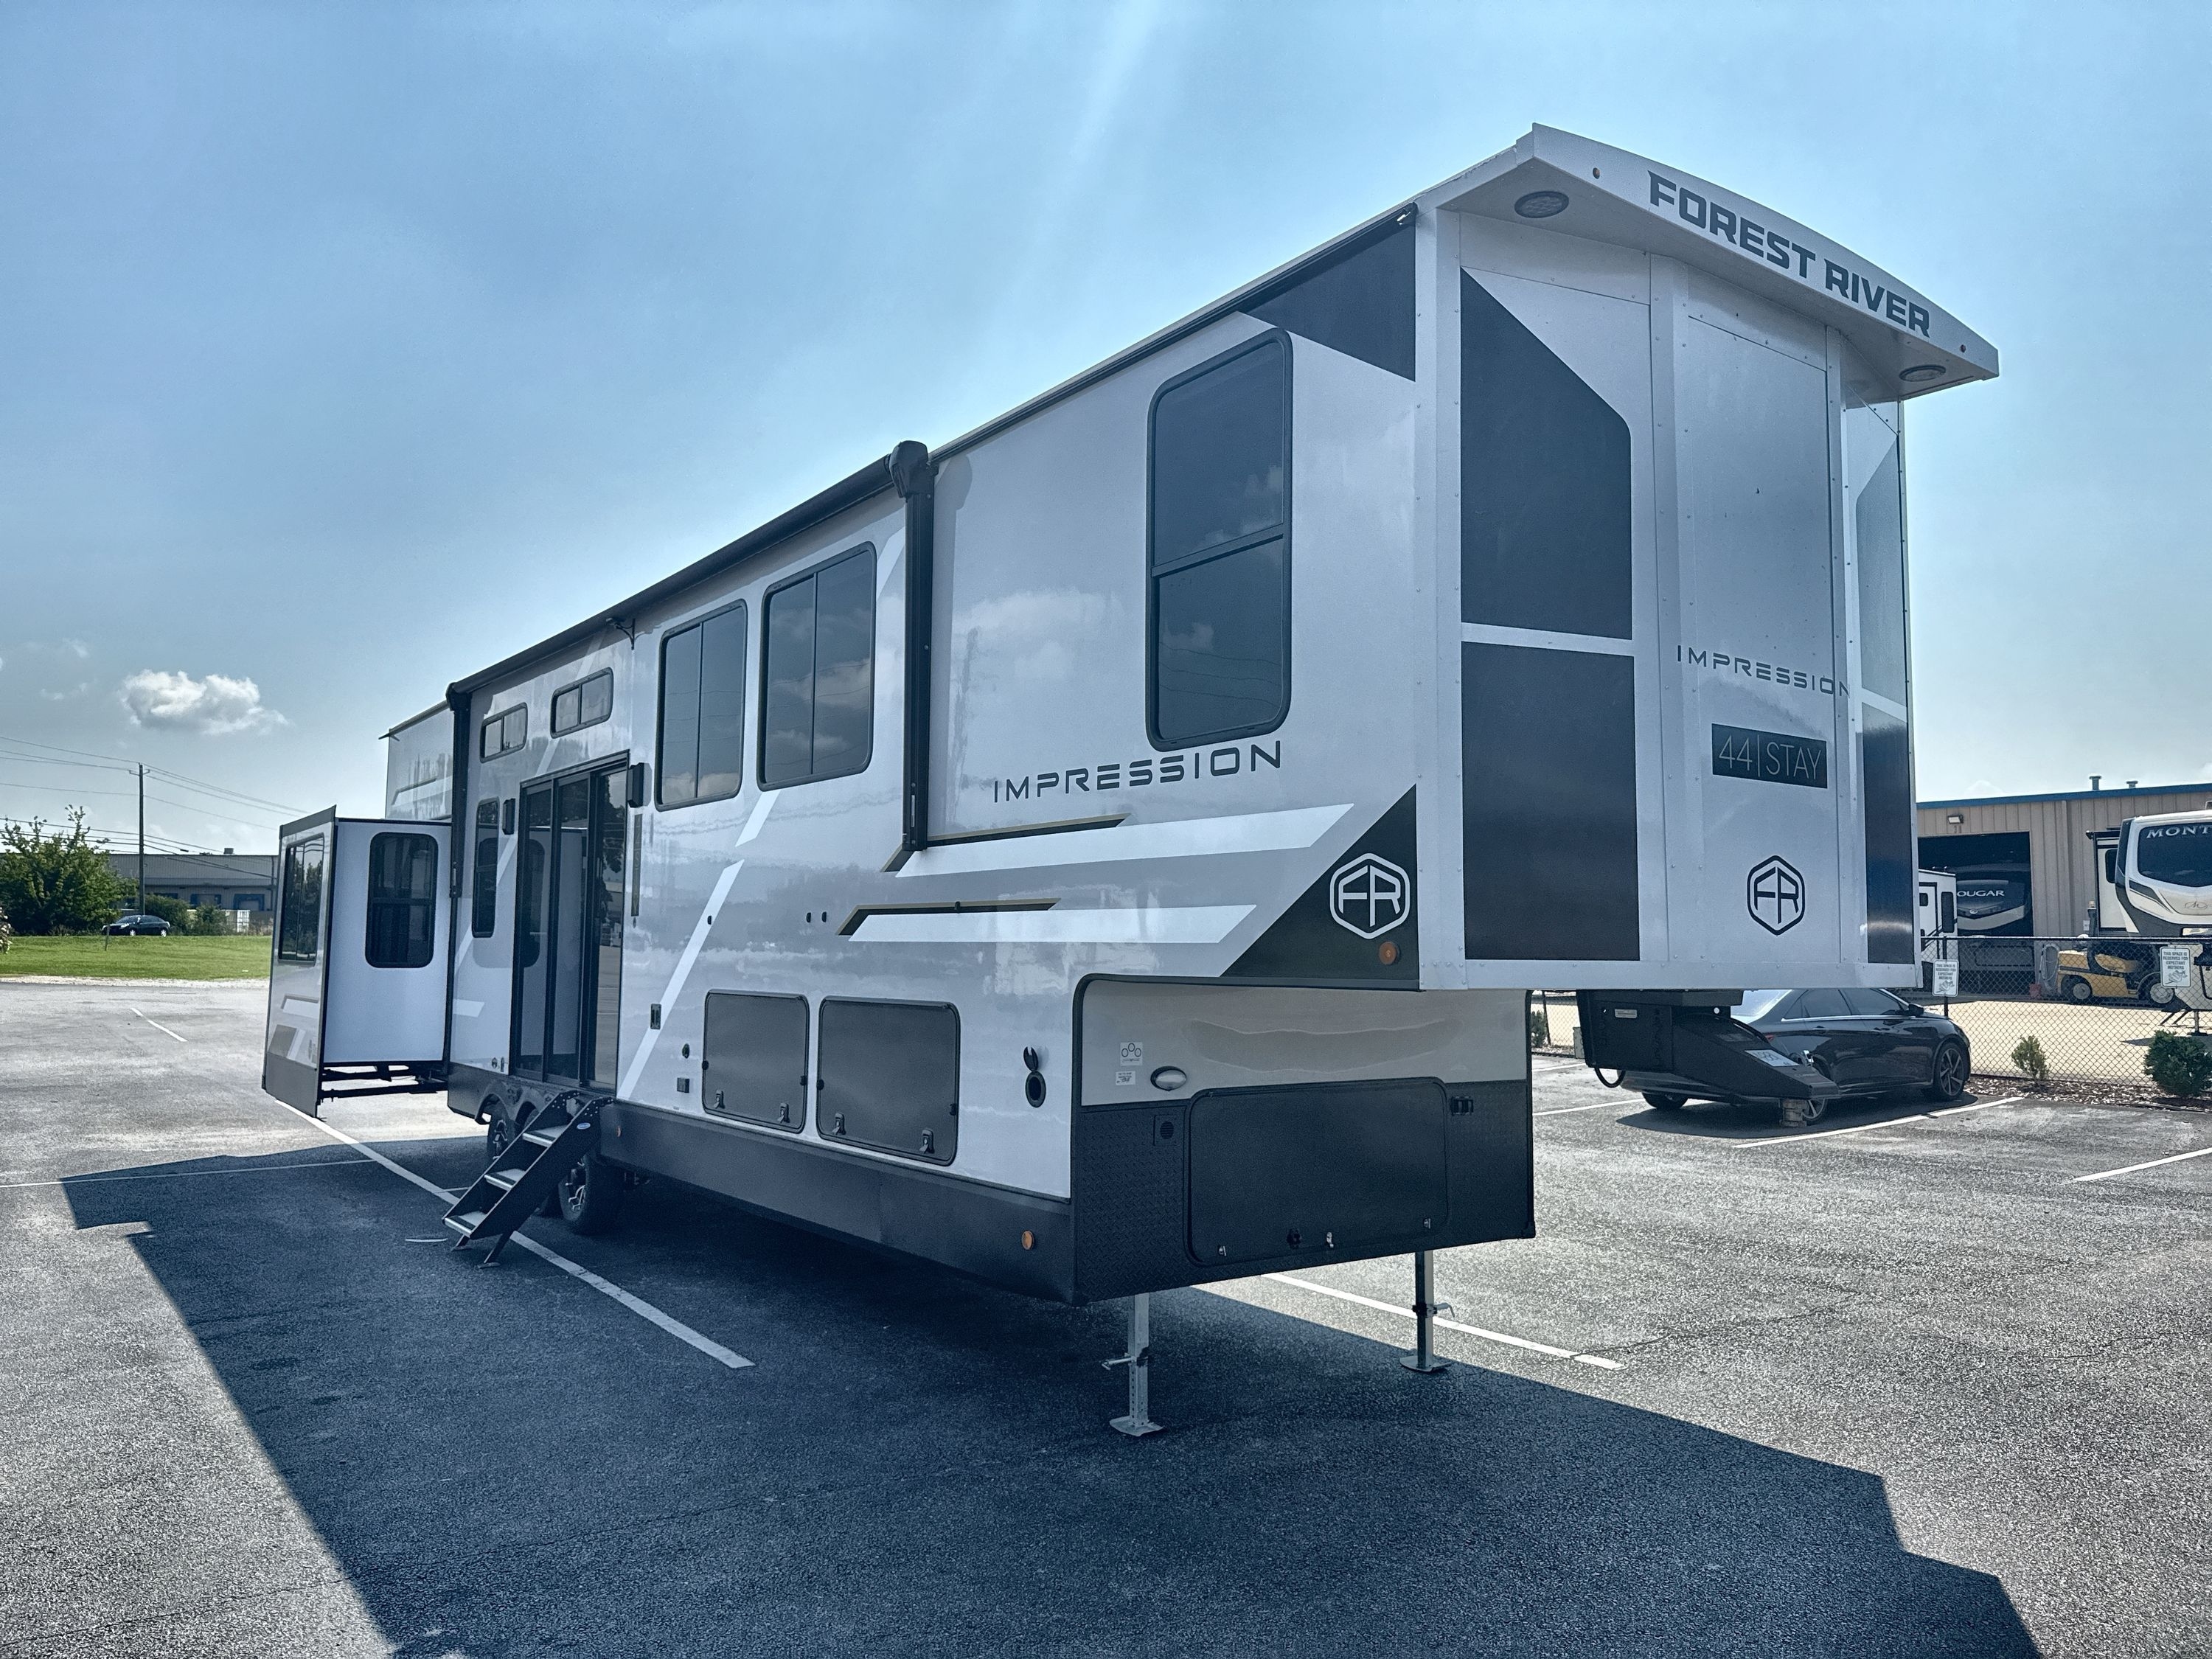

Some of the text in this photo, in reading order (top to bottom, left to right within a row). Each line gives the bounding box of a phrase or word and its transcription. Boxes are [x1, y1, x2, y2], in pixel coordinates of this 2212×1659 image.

[1648, 170, 1930, 338] FOREST RIVER
[1677, 644, 1851, 699] IMPRESSION
[993, 740, 1281, 804] IMPRESSION
[1718, 734, 1822, 780] 44 STAY
[2146, 824, 2212, 839] MONT
[1956, 889, 2005, 897] OUGAR
